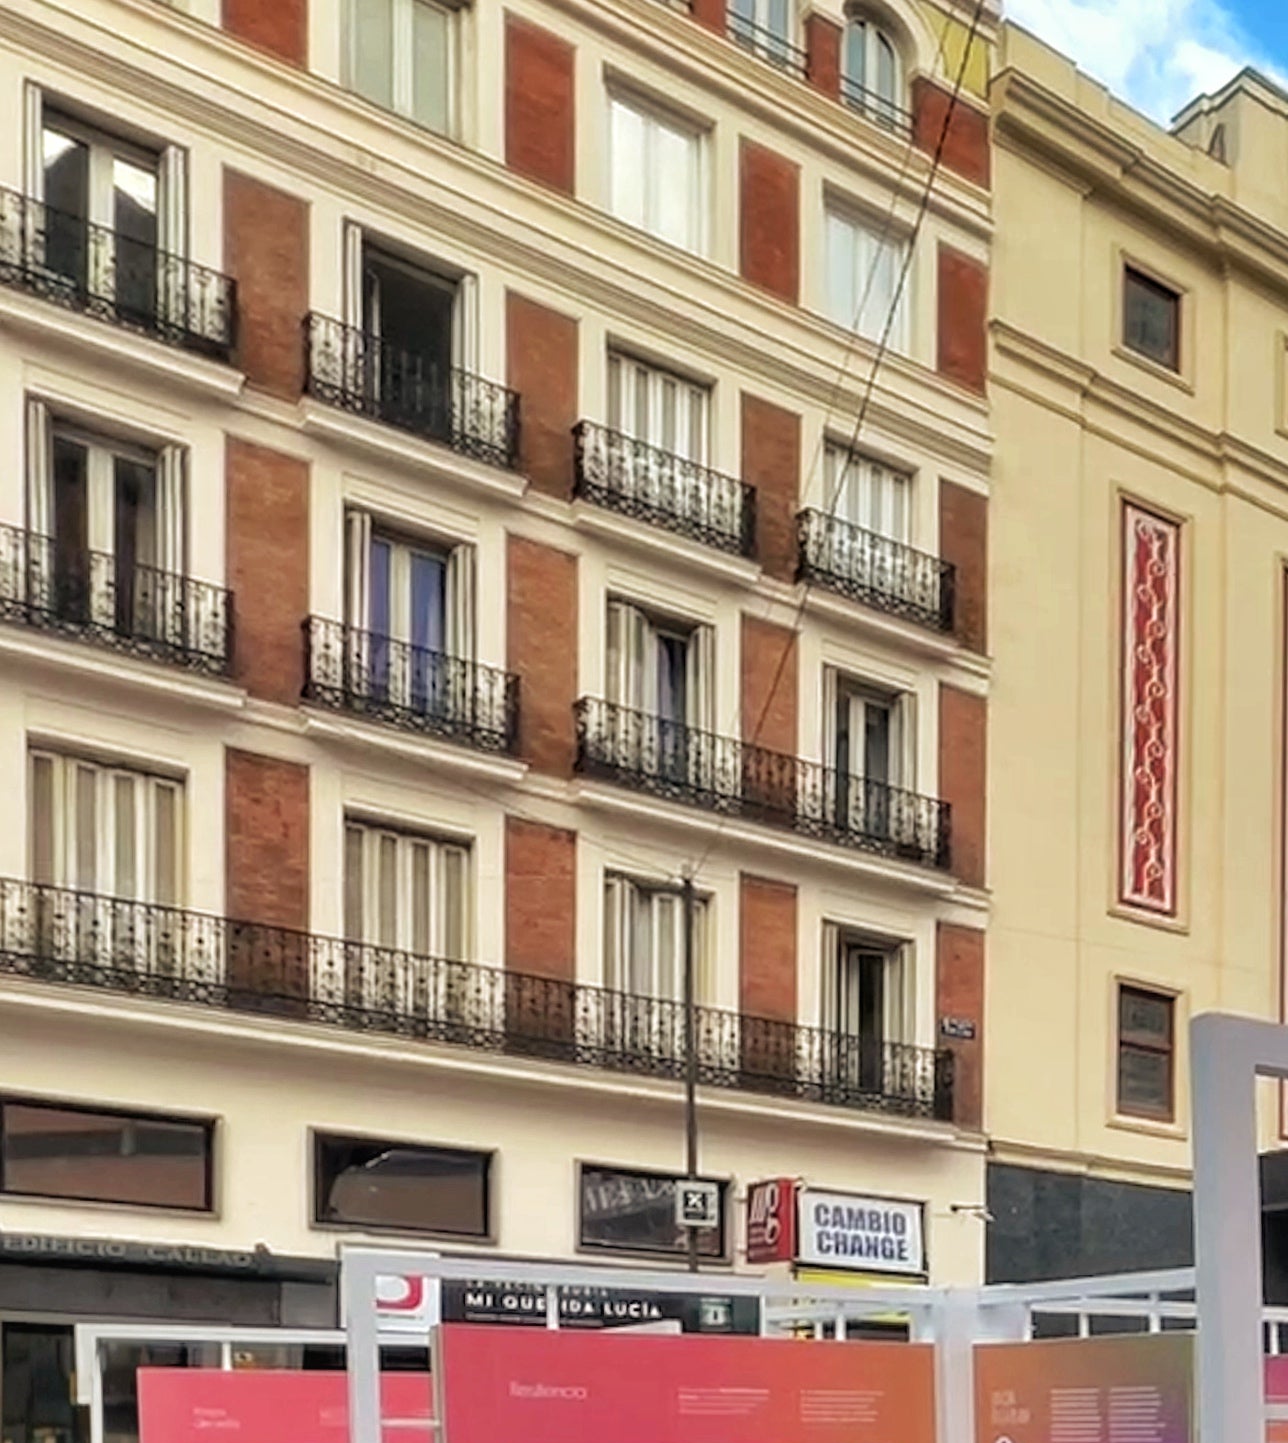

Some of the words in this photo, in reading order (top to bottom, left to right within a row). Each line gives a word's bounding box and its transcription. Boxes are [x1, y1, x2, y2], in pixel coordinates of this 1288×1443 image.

[813, 1202, 906, 1235] CAMBIO
[3, 1236, 127, 1257] EDIFICIO
[148, 1247, 250, 1268] CALLAO
[815, 1230, 909, 1261] CHANGE
[466, 1292, 494, 1308] MI
[503, 1295, 594, 1313] QUEIDA
